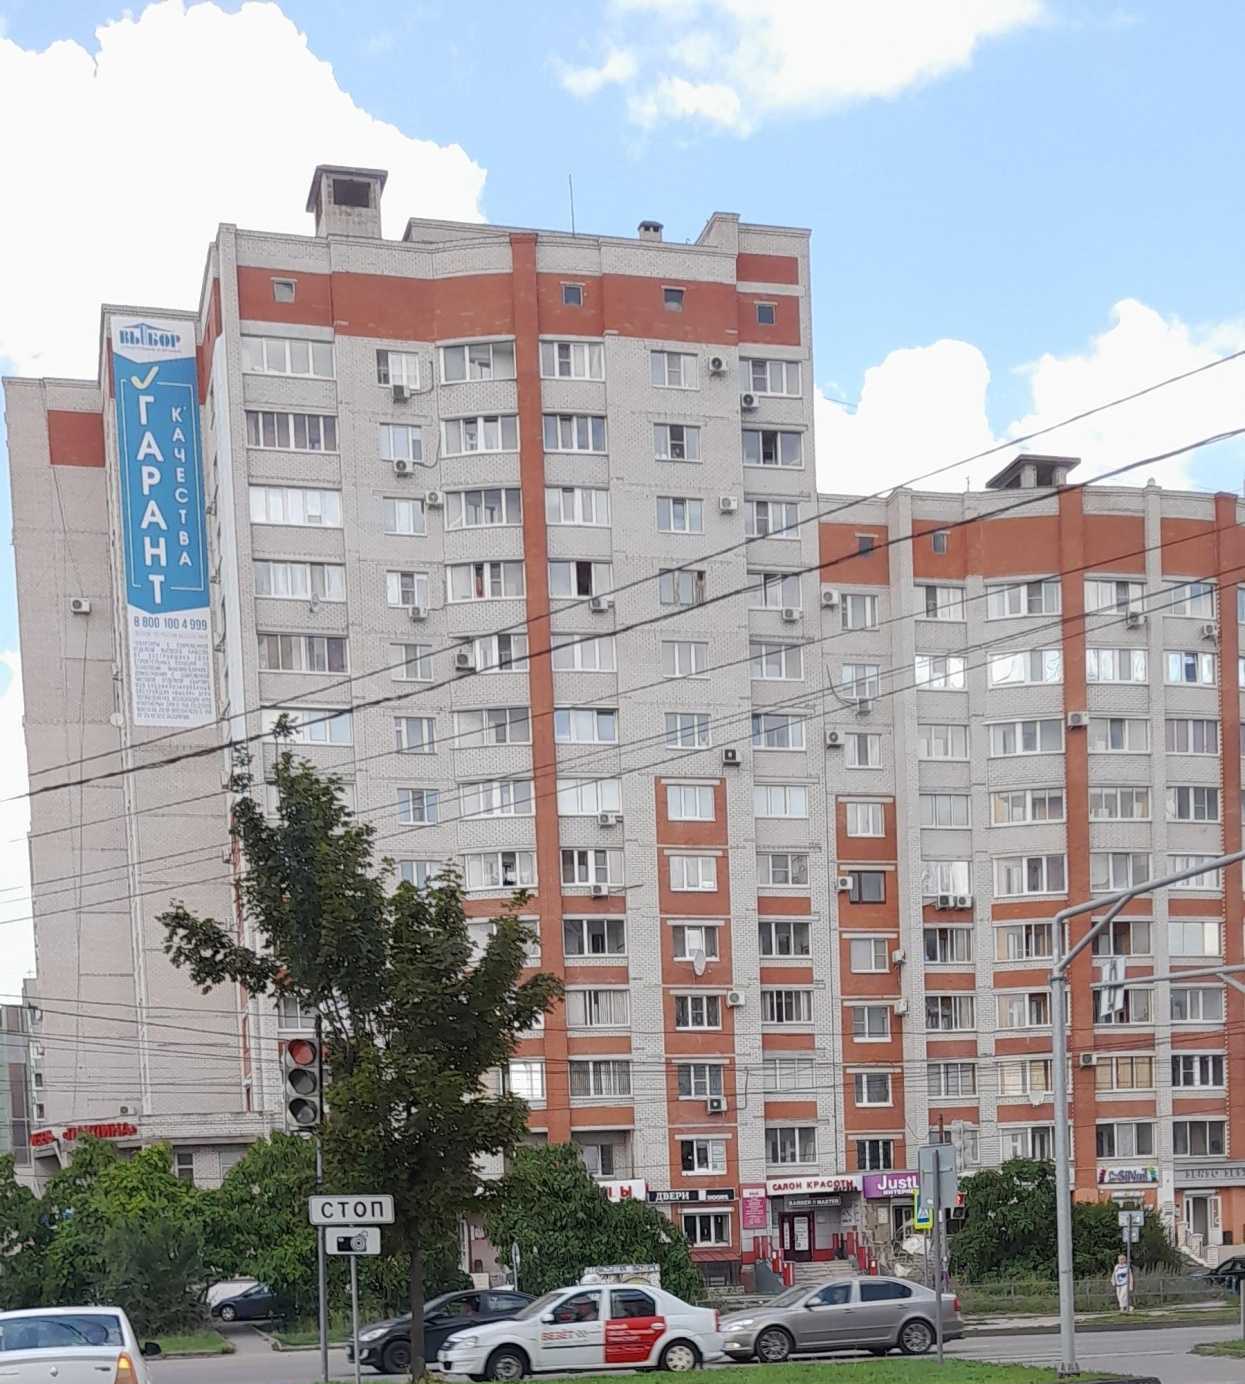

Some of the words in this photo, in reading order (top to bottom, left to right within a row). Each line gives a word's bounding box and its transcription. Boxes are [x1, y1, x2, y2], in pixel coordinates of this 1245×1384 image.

[171, 406, 194, 569] КАЧЕСТВА
[136, 395, 168, 605] ГАРАНТ
[142, 616, 160, 629] 800
[164, 617, 180, 630] 100
[772, 1180, 803, 1192] САЛОН
[806, 1179, 854, 1190] КРАСОТЫ
[876, 1174, 920, 1190] JustL
[655, 1191, 690, 1201] ДВЕРИ
[321, 1201, 384, 1218] СТОП
